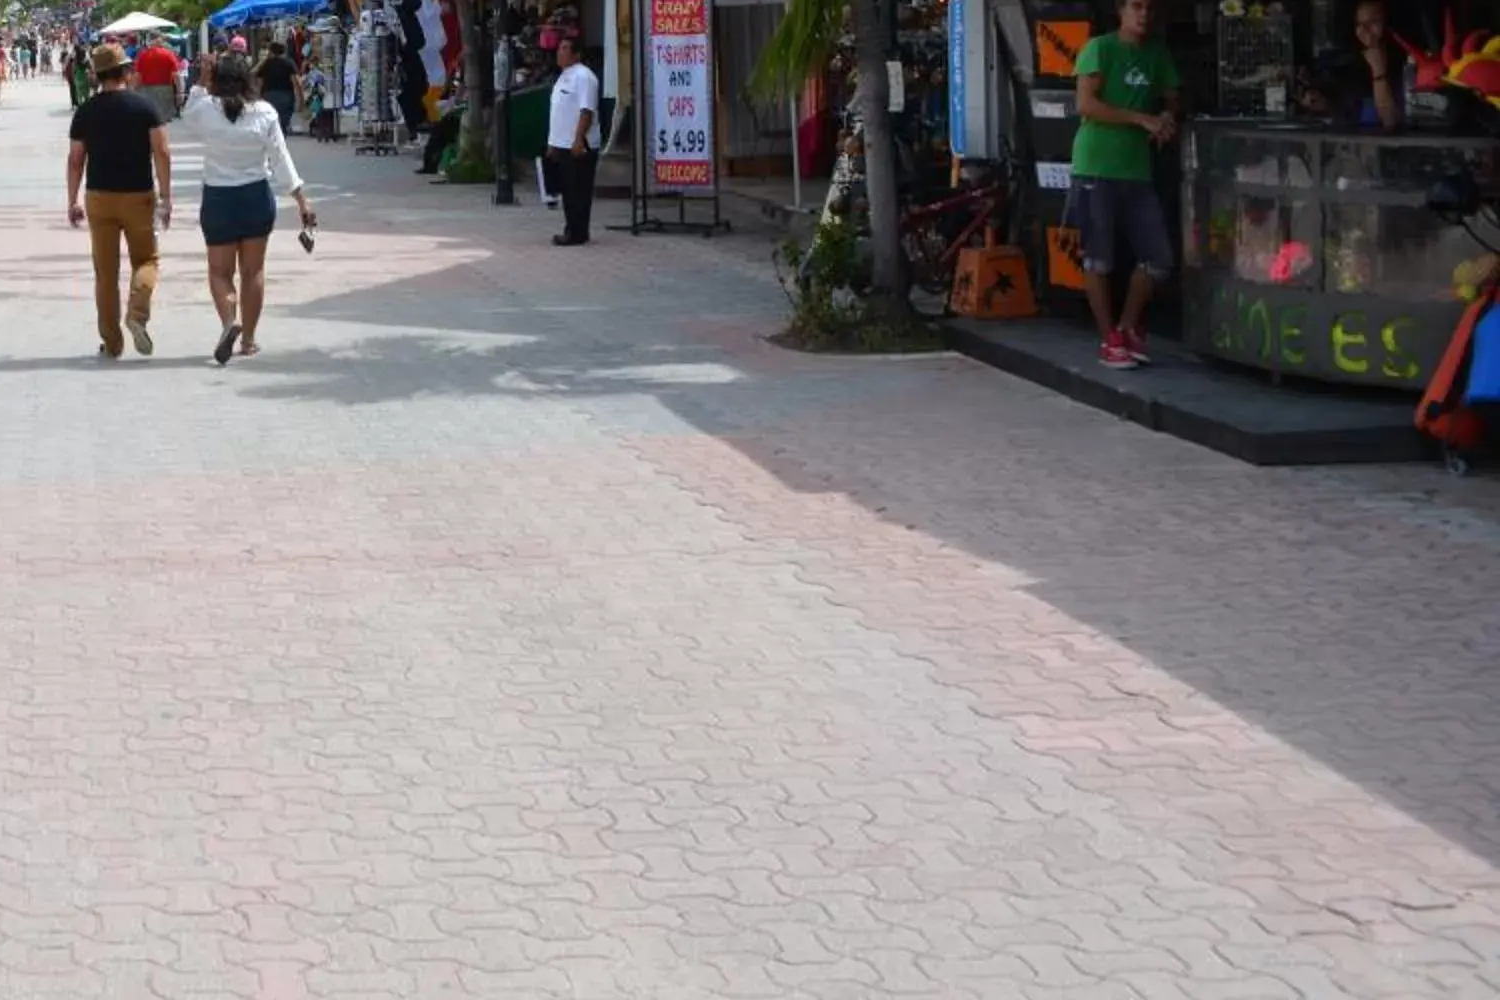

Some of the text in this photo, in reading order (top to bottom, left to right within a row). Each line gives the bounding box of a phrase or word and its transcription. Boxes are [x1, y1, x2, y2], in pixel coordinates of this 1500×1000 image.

[655, 0, 701, 16] CRAZY
[655, 17, 701, 33] SALES
[656, 45, 705, 66] T-SHIRTS
[668, 71, 692, 87] AND
[668, 96, 695, 118] CAPS
[672, 128, 706, 153] 4.99
[657, 163, 707, 183] WELCOME
